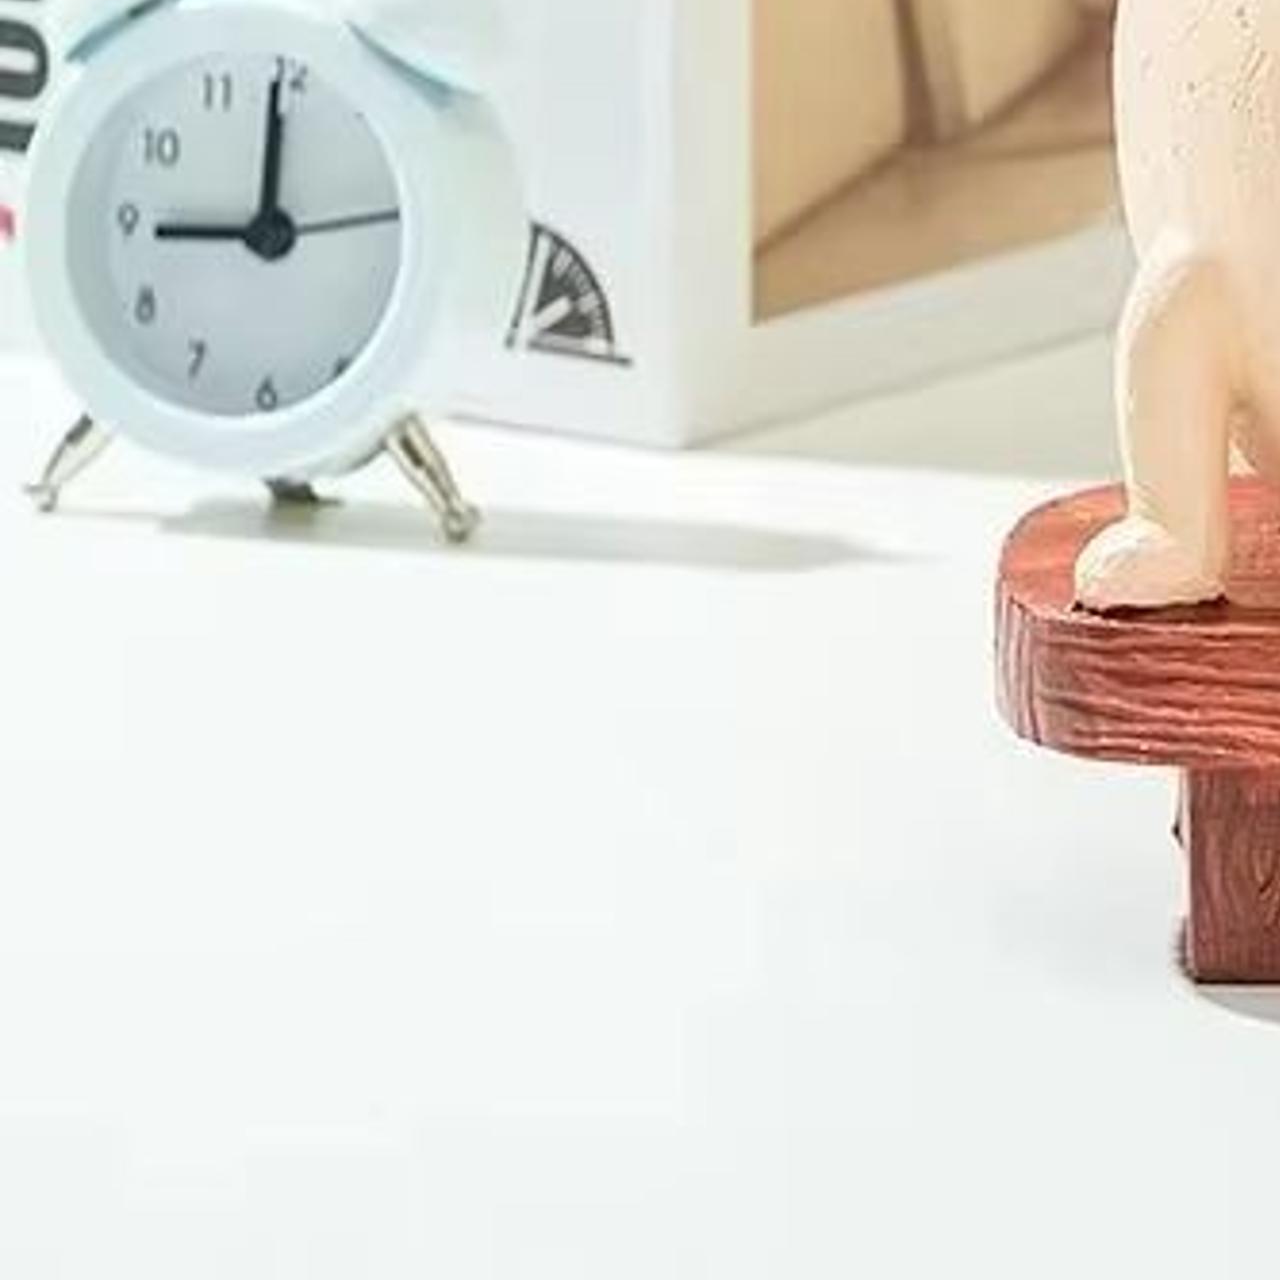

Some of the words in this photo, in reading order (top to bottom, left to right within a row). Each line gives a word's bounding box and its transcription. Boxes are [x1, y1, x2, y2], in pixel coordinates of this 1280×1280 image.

[203, 72, 234, 112] 11
[143, 128, 181, 167] 10
[116, 203, 140, 240] 9
[134, 286, 156, 326] 8
[188, 340, 207, 380] 7
[255, 377, 278, 411] 6
